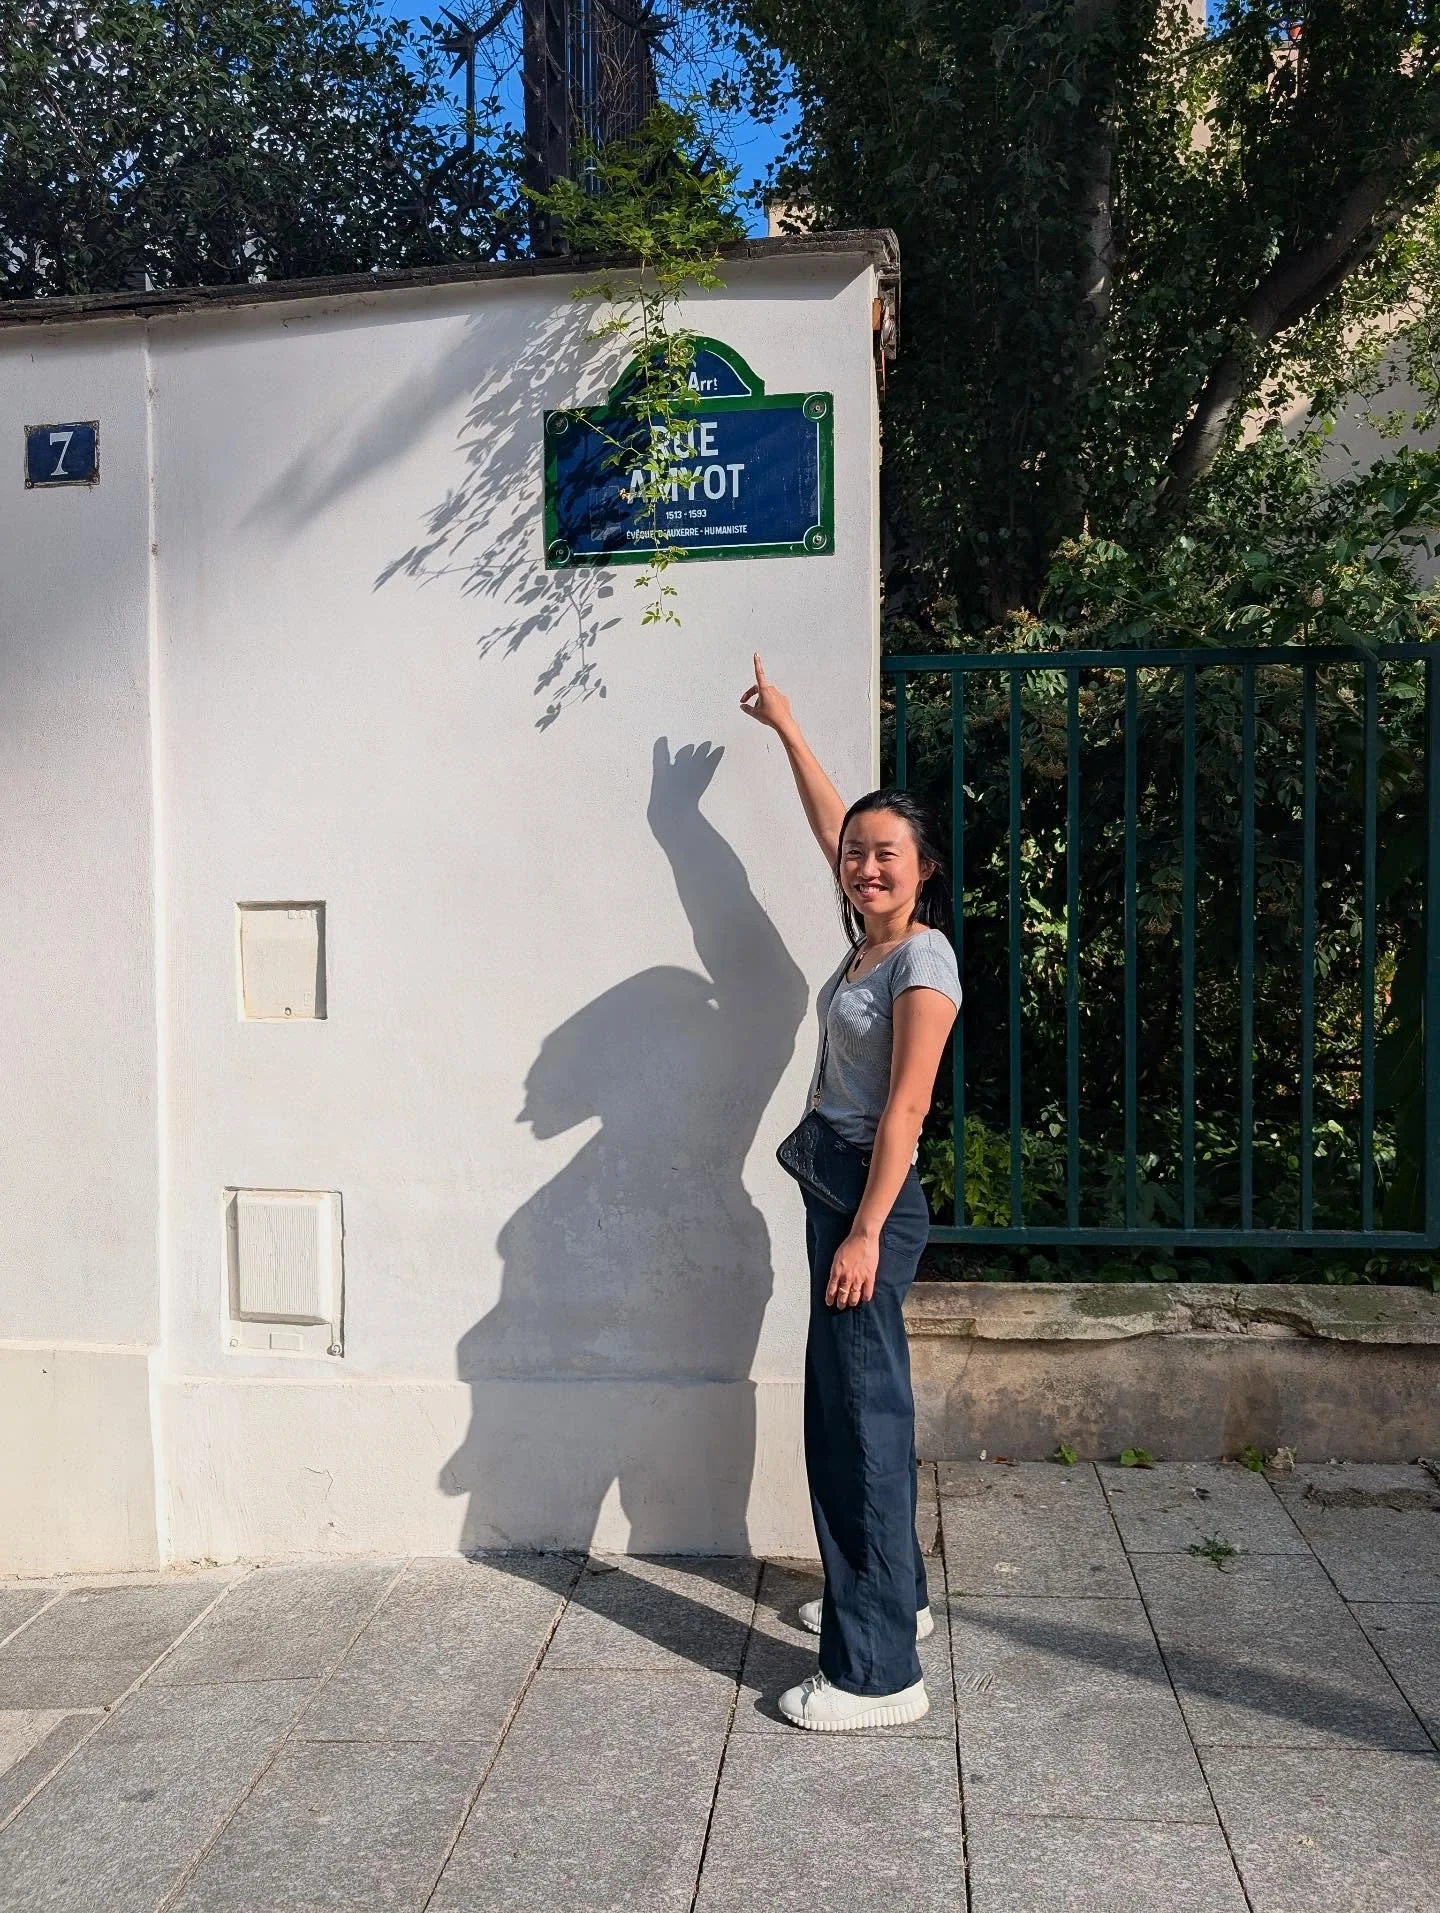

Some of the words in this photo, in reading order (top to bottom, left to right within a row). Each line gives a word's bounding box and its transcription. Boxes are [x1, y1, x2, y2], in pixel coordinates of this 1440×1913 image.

[49, 431, 74, 476] 7
[651, 421, 719, 460] RUE
[627, 463, 745, 504] AMYOT
[704, 524, 748, 535] HUMANISTE
